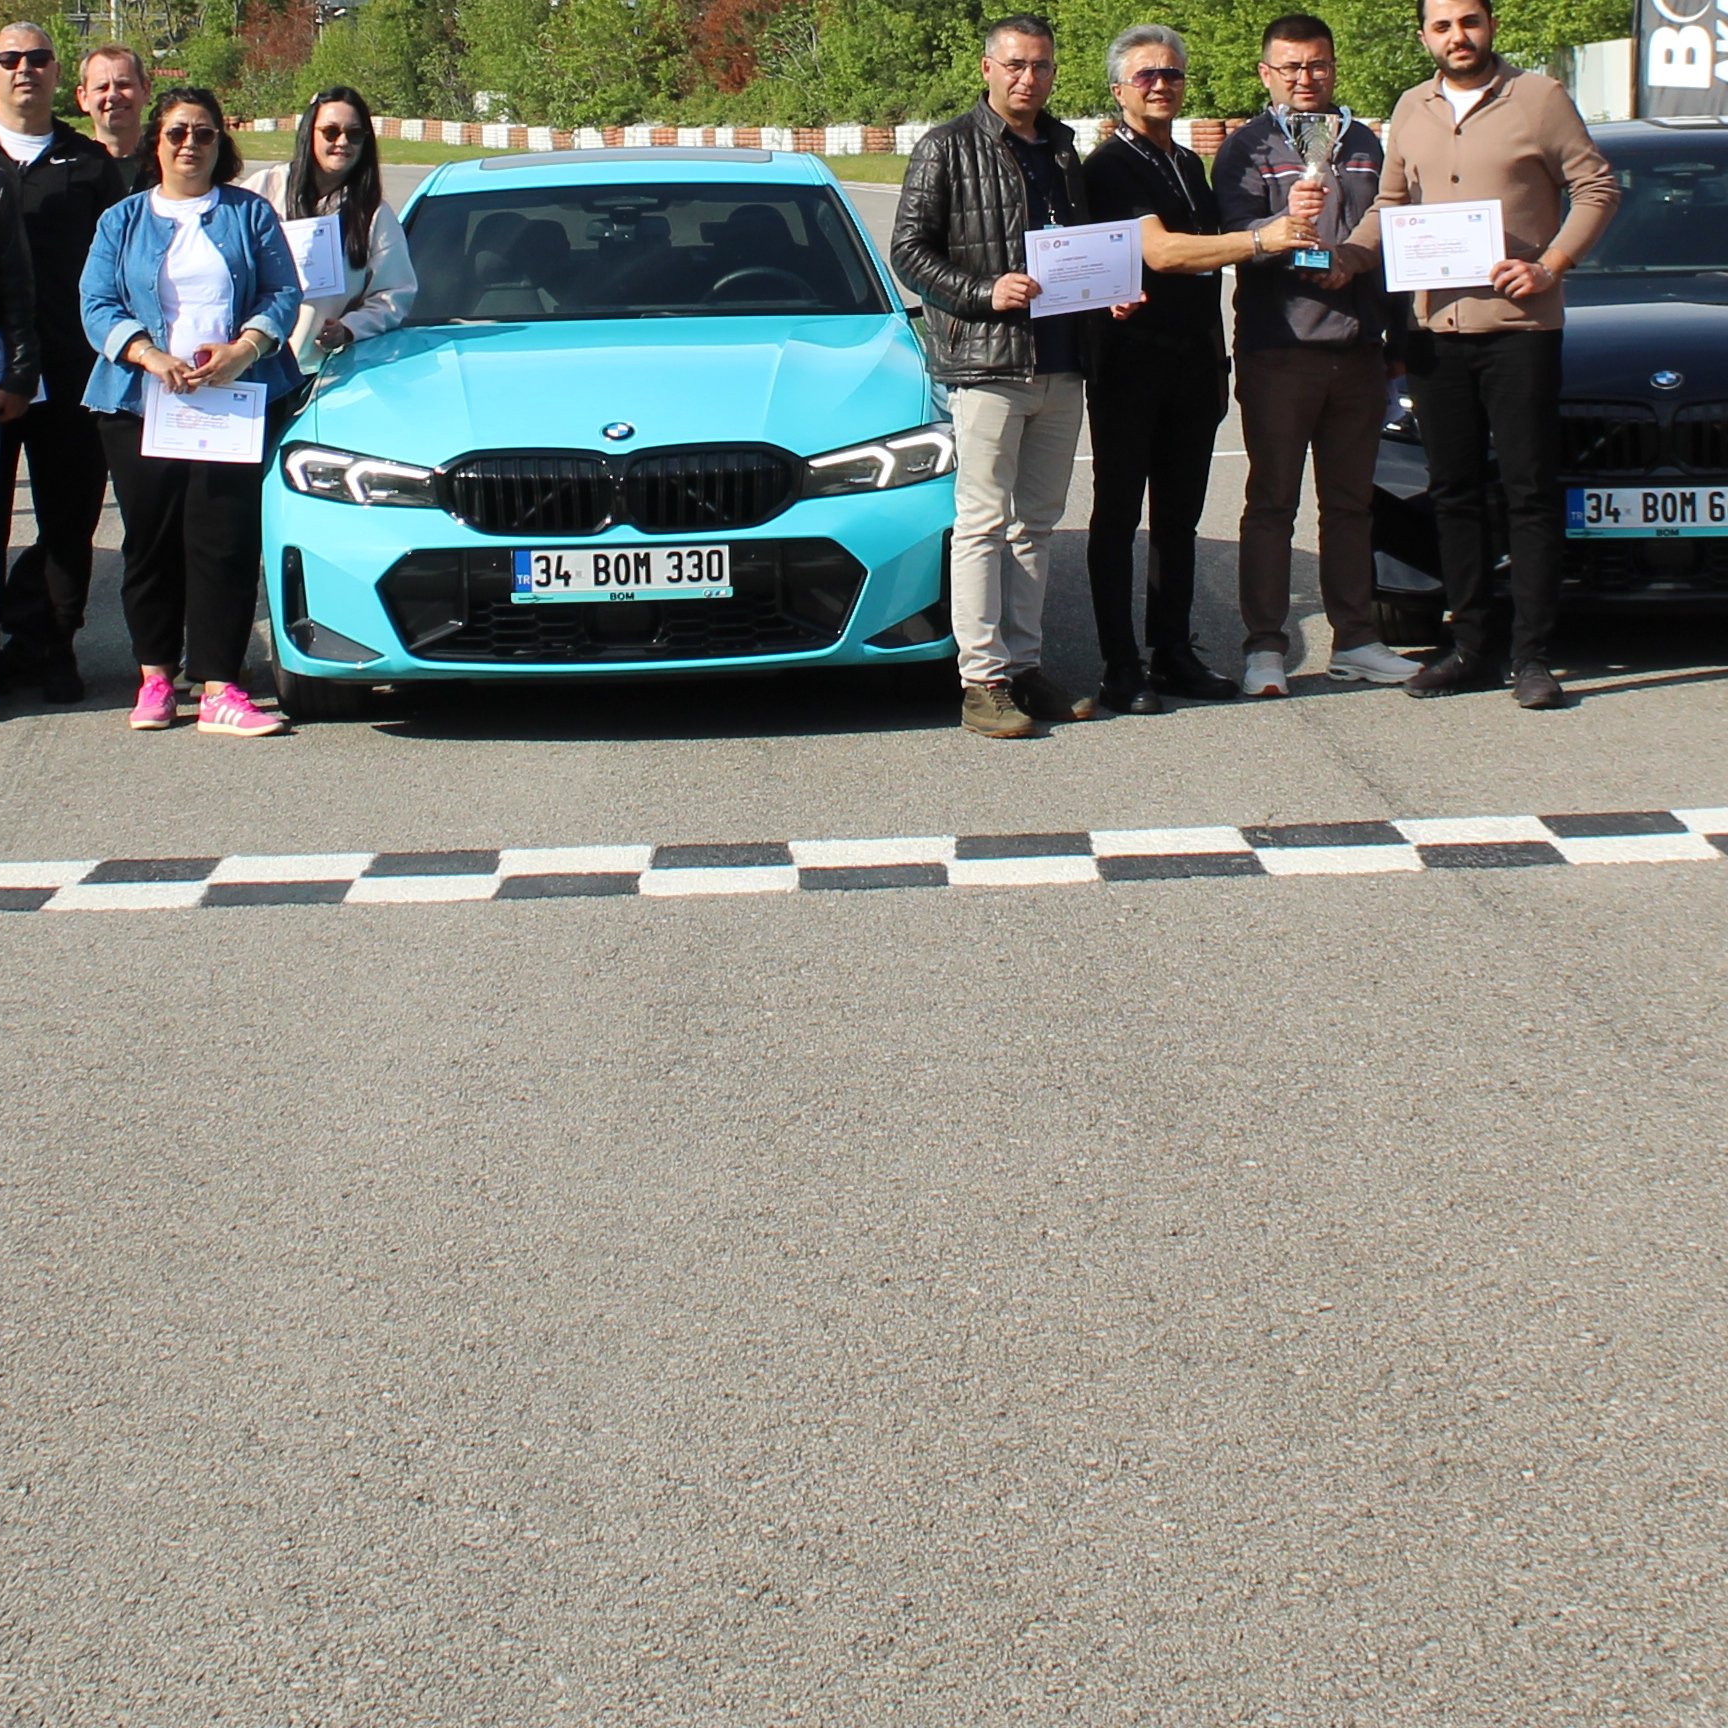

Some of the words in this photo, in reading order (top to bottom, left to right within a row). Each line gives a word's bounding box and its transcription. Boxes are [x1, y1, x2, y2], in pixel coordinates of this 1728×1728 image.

[1586, 493, 1621, 524] 34
[1642, 491, 1697, 523] BOM
[516, 574, 531, 585] TR
[534, 554, 572, 588] 34
[593, 552, 652, 586] BOM
[666, 549, 724, 584] 330
[609, 592, 636, 602] BOM
